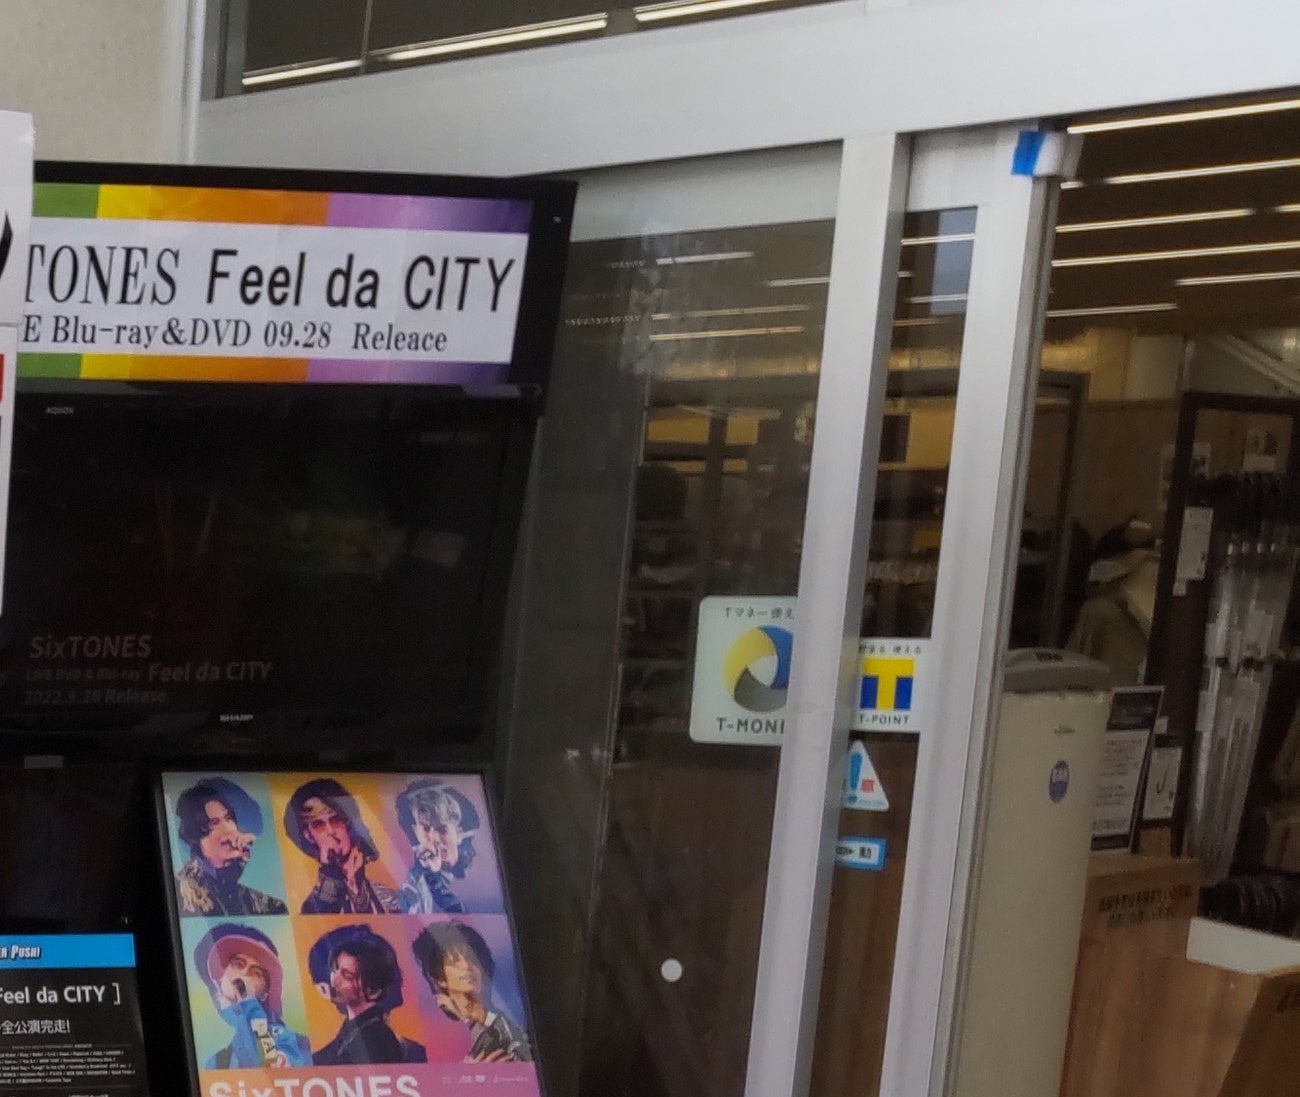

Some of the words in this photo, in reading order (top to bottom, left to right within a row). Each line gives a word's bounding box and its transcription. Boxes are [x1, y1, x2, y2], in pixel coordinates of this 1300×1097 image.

[24, 244, 180, 304] TONES
[206, 249, 305, 307] Feel
[327, 253, 380, 309] da
[404, 256, 516, 312] CITY
[263, 322, 332, 350] 09.28
[352, 322, 448, 352] Releace
[30, 634, 152, 659] SixTONES
[226, 661, 273, 681] CITY
[858, 714, 910, 725] T-POINT
[36, 986, 58, 1004] da
[64, 985, 106, 1003] CITY
